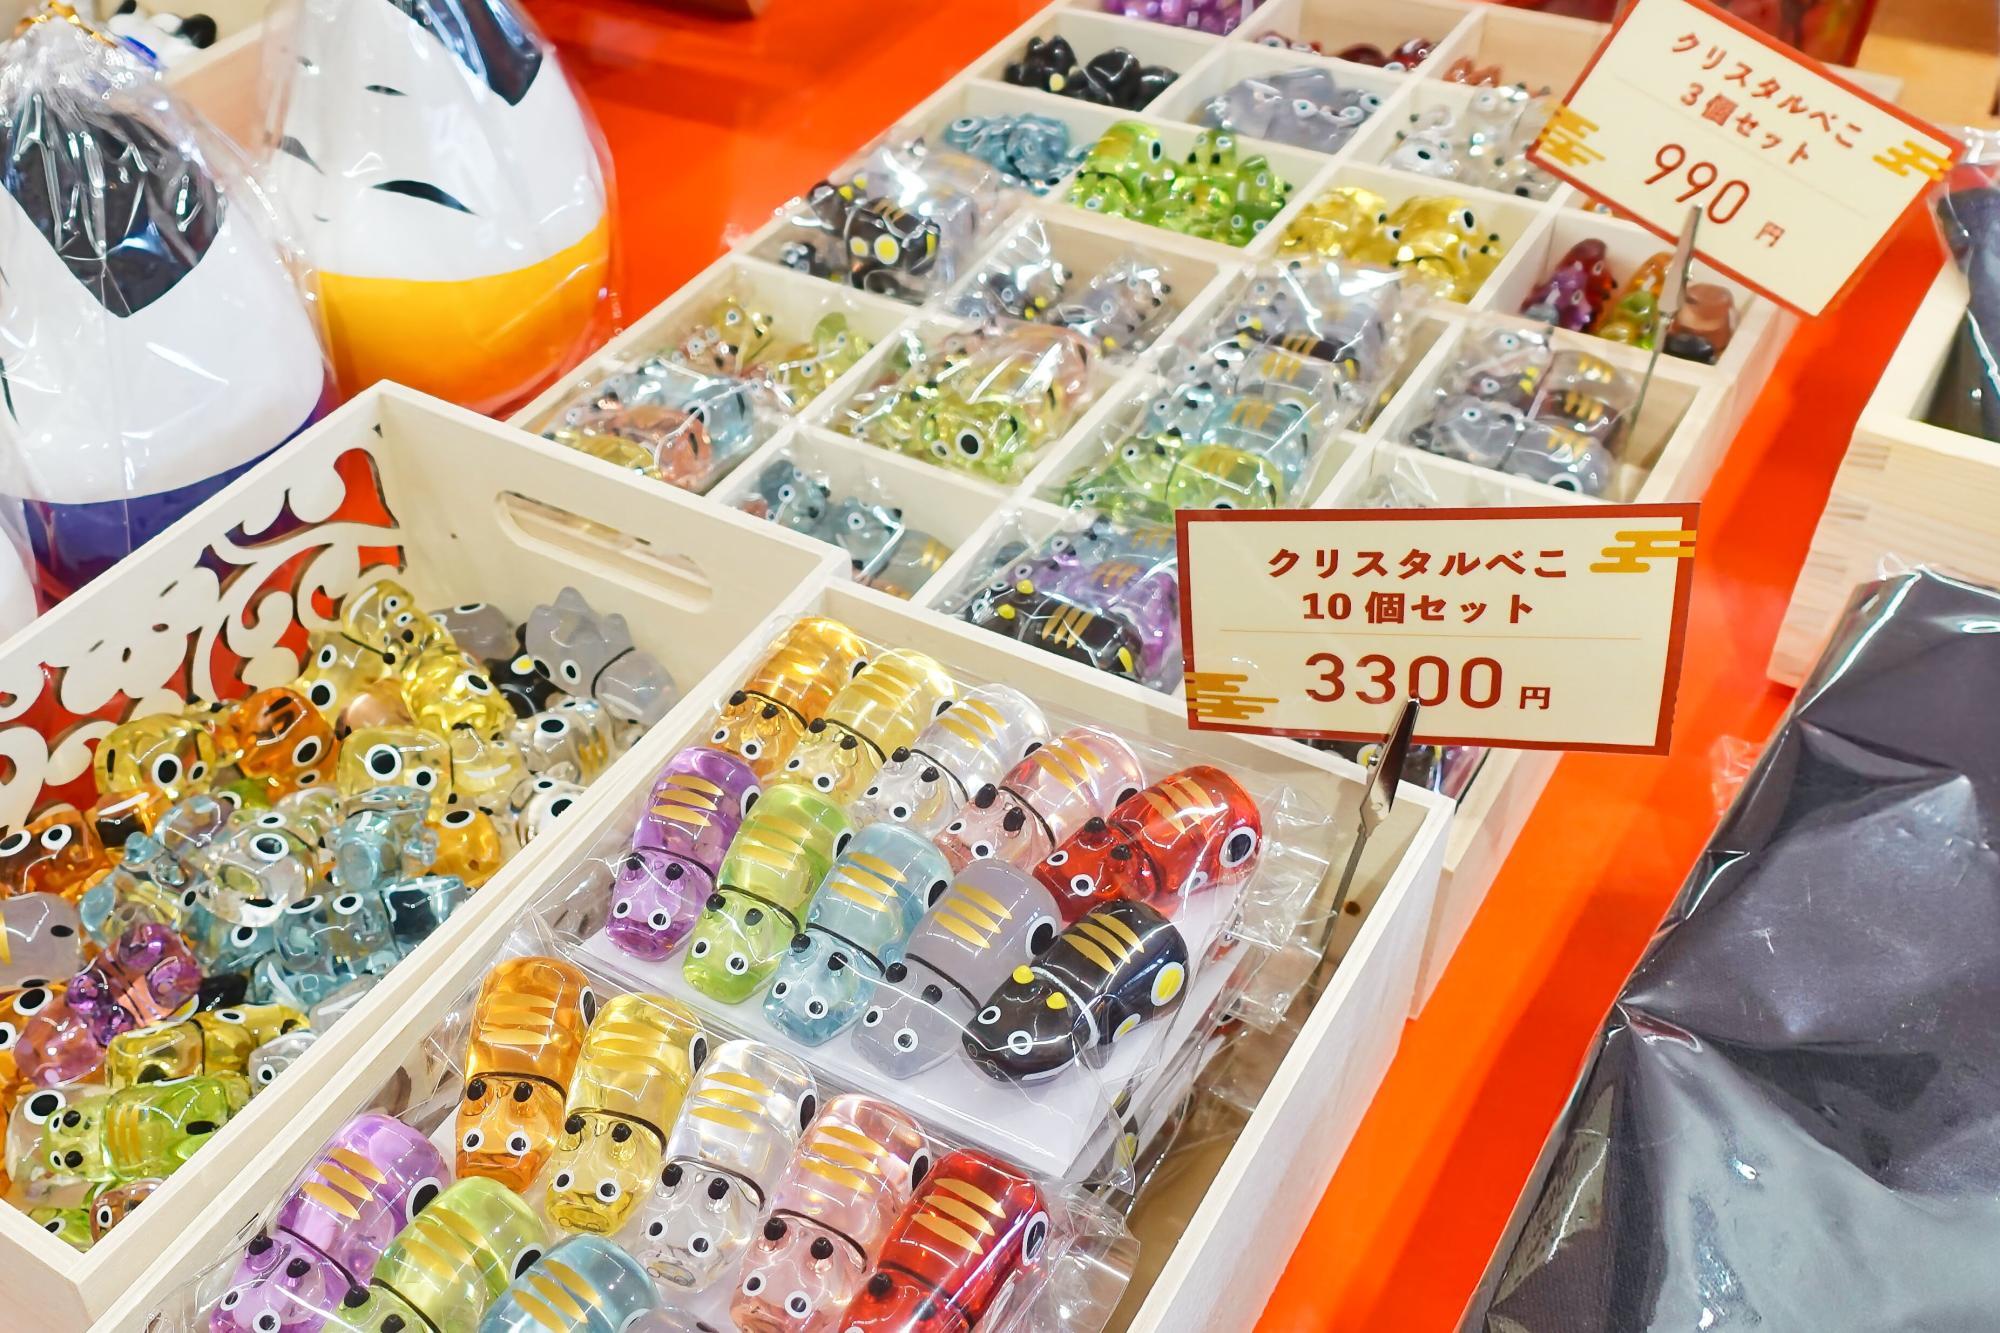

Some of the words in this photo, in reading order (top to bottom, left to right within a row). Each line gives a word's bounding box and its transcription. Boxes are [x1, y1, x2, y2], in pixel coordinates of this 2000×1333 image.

[1671, 33, 1863, 149] クリスタルべこ
[1680, 82, 1809, 164] 3個セット
[1267, 548, 1567, 579] クリスタルべこ
